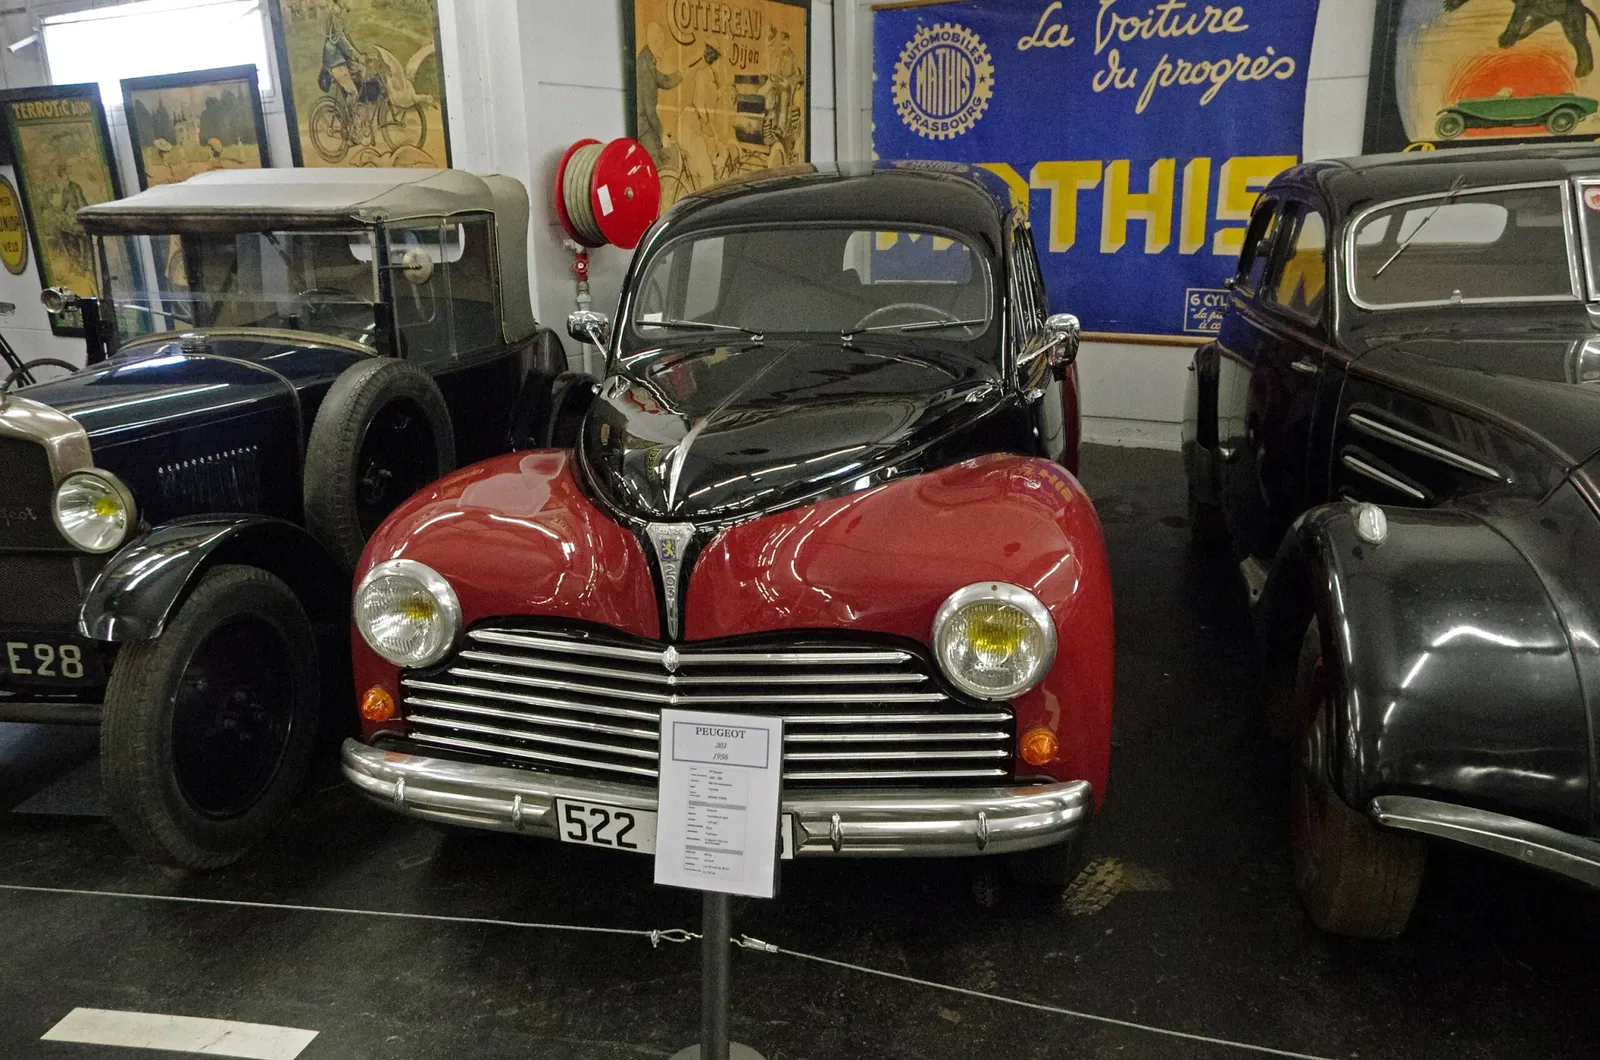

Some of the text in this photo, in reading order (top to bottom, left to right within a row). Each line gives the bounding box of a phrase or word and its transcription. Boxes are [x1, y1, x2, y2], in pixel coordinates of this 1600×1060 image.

[666, 0, 762, 46] COTTEREAU
[1017, 0, 1249, 55] La Voiture
[728, 42, 759, 70] Dijon
[904, 31, 984, 70] AUTOMOBILES
[915, 47, 971, 116] MATHIS
[1092, 45, 1296, 114] du progrès
[12, 100, 61, 119] TERROT
[902, 96, 982, 132] STRASBOURG
[875, 155, 1298, 257] THIS
[695, 727, 747, 739] PEUGEOT
[714, 741, 728, 750] 203
[712, 752, 729, 761] 1956
[564, 803, 638, 849] 522
